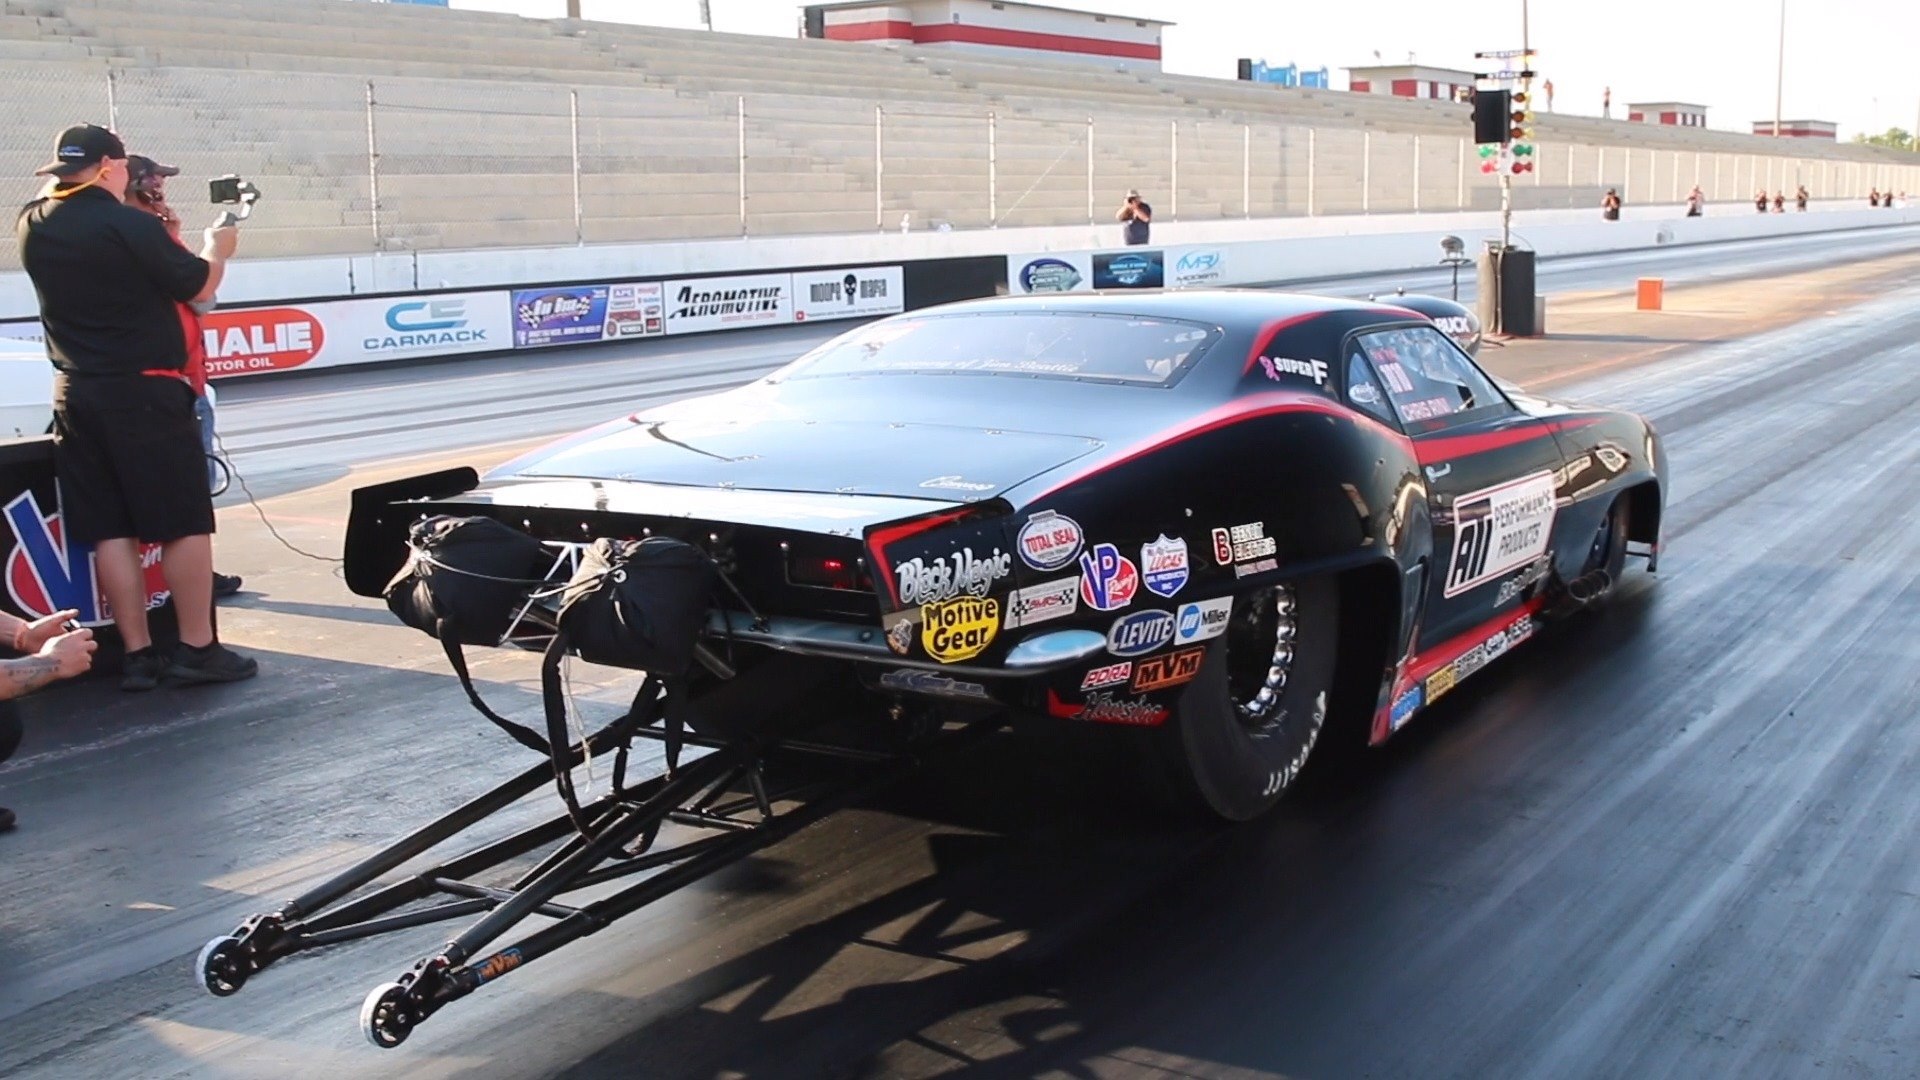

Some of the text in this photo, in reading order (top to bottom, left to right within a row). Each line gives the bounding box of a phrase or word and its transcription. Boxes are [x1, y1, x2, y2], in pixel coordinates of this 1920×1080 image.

[203, 321, 313, 358] ALIE
[363, 329, 487, 350] CARMACK
[205, 357, 274, 373] OTOR OIL
[1273, 356, 1313, 377] SUPER
[1024, 527, 1077, 553] TOTAL SEAL
[1498, 522, 1542, 559] PRODUCTS
[1150, 552, 1184, 571] LUCAS
[895, 547, 1011, 605] Black Magic
[1079, 543, 1120, 610] VP
[925, 599, 996, 631] Motive
[1201, 608, 1228, 626] Miller
[933, 626, 989, 652] Gear
[1108, 615, 1176, 651] CLEVITE
[1135, 651, 1202, 687] MVM
[481, 951, 521, 979] MVM
